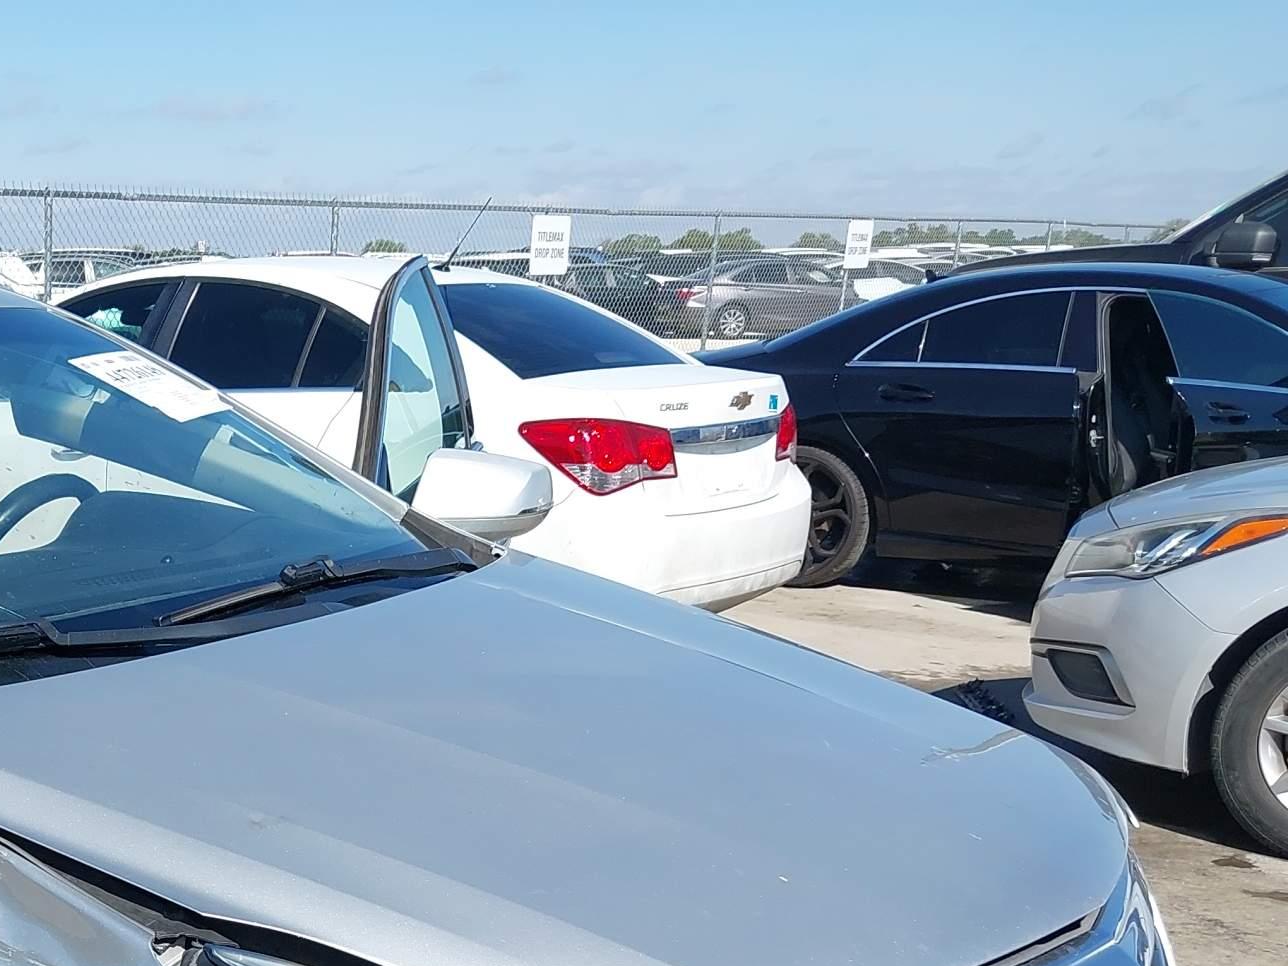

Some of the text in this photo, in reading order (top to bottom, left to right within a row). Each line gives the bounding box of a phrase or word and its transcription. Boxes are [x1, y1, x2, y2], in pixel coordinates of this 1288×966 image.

[537, 231, 565, 242] TITLEMAX
[534, 247, 565, 259] DROP ZONE
[659, 402, 689, 412] CRUZE
